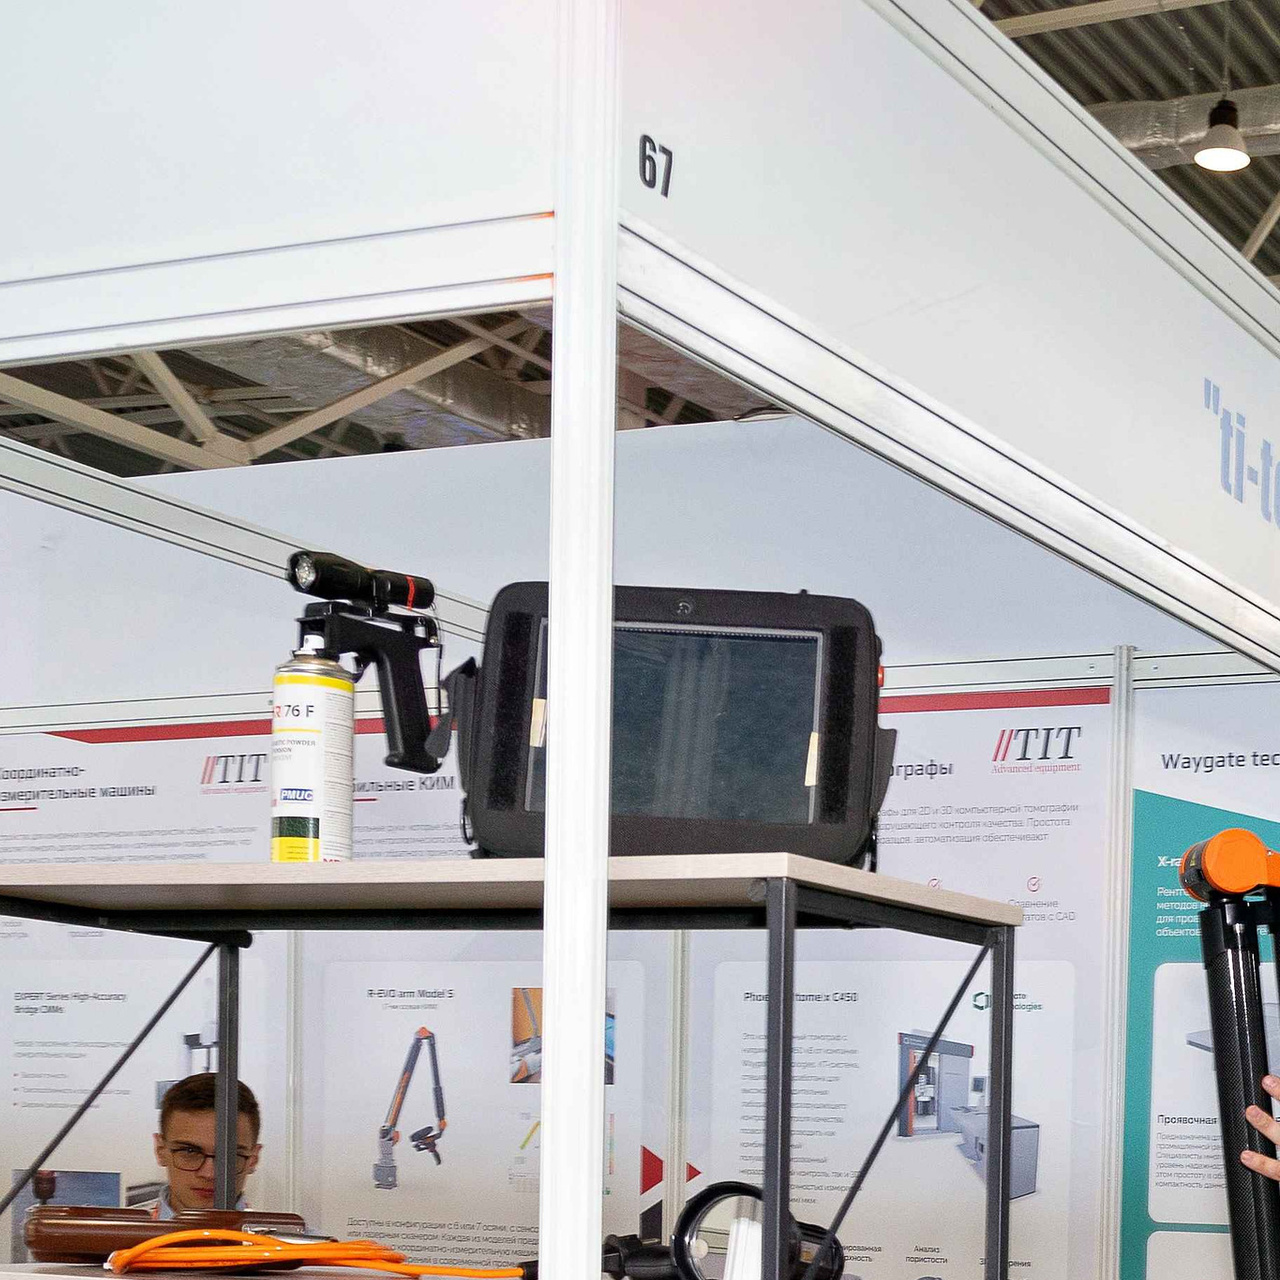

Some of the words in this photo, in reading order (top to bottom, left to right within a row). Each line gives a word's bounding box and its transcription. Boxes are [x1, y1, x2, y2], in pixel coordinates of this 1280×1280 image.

[639, 134, 673, 199] 67
[284, 704, 300, 718] 76
[305, 704, 315, 718] F
[1161, 752, 1246, 773] Waygate
[0, 766, 86, 783] оординатно-
[889, 759, 954, 780] ографы
[353, 777, 415, 793] бильные
[419, 775, 455, 791] КИМ
[0, 787, 97, 804] змерительные
[99, 785, 157, 798] машины
[281, 788, 314, 801] PMUC
[1023, 803, 1079, 815] томографии
[1026, 817, 1071, 829] Простота
[1157, 856, 1181, 867] X-ra
[743, 991, 769, 1002] Phoe
[1012, 1002, 1042, 1012] ologies
[1157, 1114, 1218, 1126] Проявочная
[913, 1245, 940, 1254] Анализ
[905, 1255, 948, 1265] пористости
